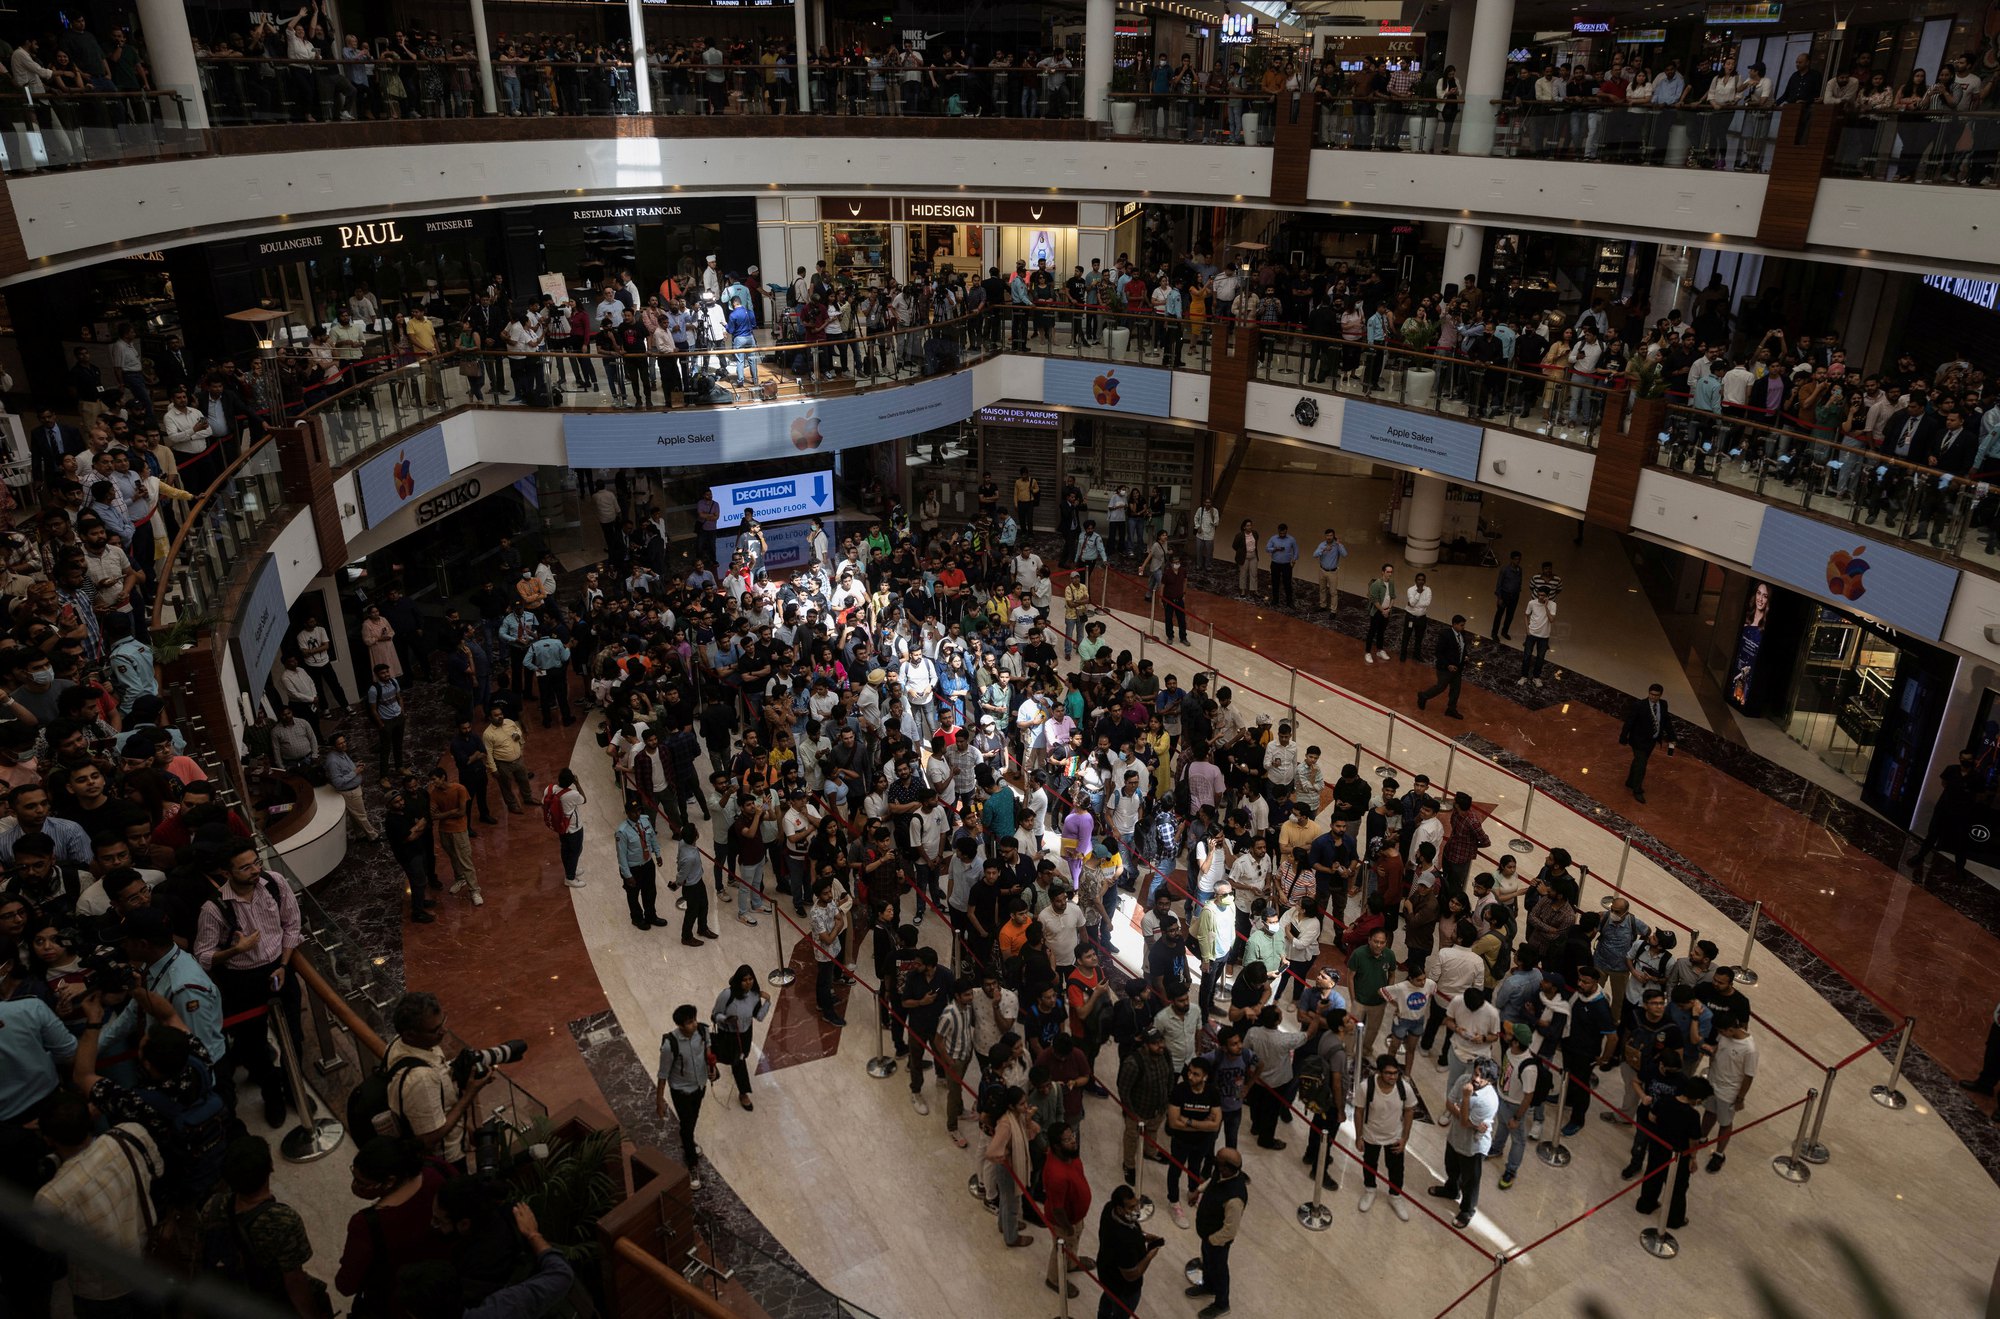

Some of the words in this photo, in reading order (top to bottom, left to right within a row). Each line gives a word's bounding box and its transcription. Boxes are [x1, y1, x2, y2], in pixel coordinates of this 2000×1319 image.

[1574, 22, 1595, 30] FROZEN
[1596, 22, 1610, 32] FUN
[902, 30, 922, 40] NIKE
[1388, 41, 1414, 51] KFC
[574, 208, 634, 220] RESTAURANT
[912, 204, 975, 218] HIDESIGN
[426, 219, 474, 232] PATISSERIE
[338, 221, 404, 248] PAUL
[260, 236, 323, 254] BOULANGERIE
[980, 407, 1010, 416] MAISON
[1026, 411, 1058, 420] PARFUMS
[657, 436, 686, 446] Apple
[687, 434, 715, 444] Saket
[1387, 426, 1410, 438] Apple
[1411, 432, 1434, 444] Saket
[736, 484, 792, 501] DECATHLON
[416, 478, 481, 525] SEIKO
[724, 512, 744, 522] LOWE
[753, 506, 782, 517] GROUND
[784, 504, 807, 512] FLOOR
